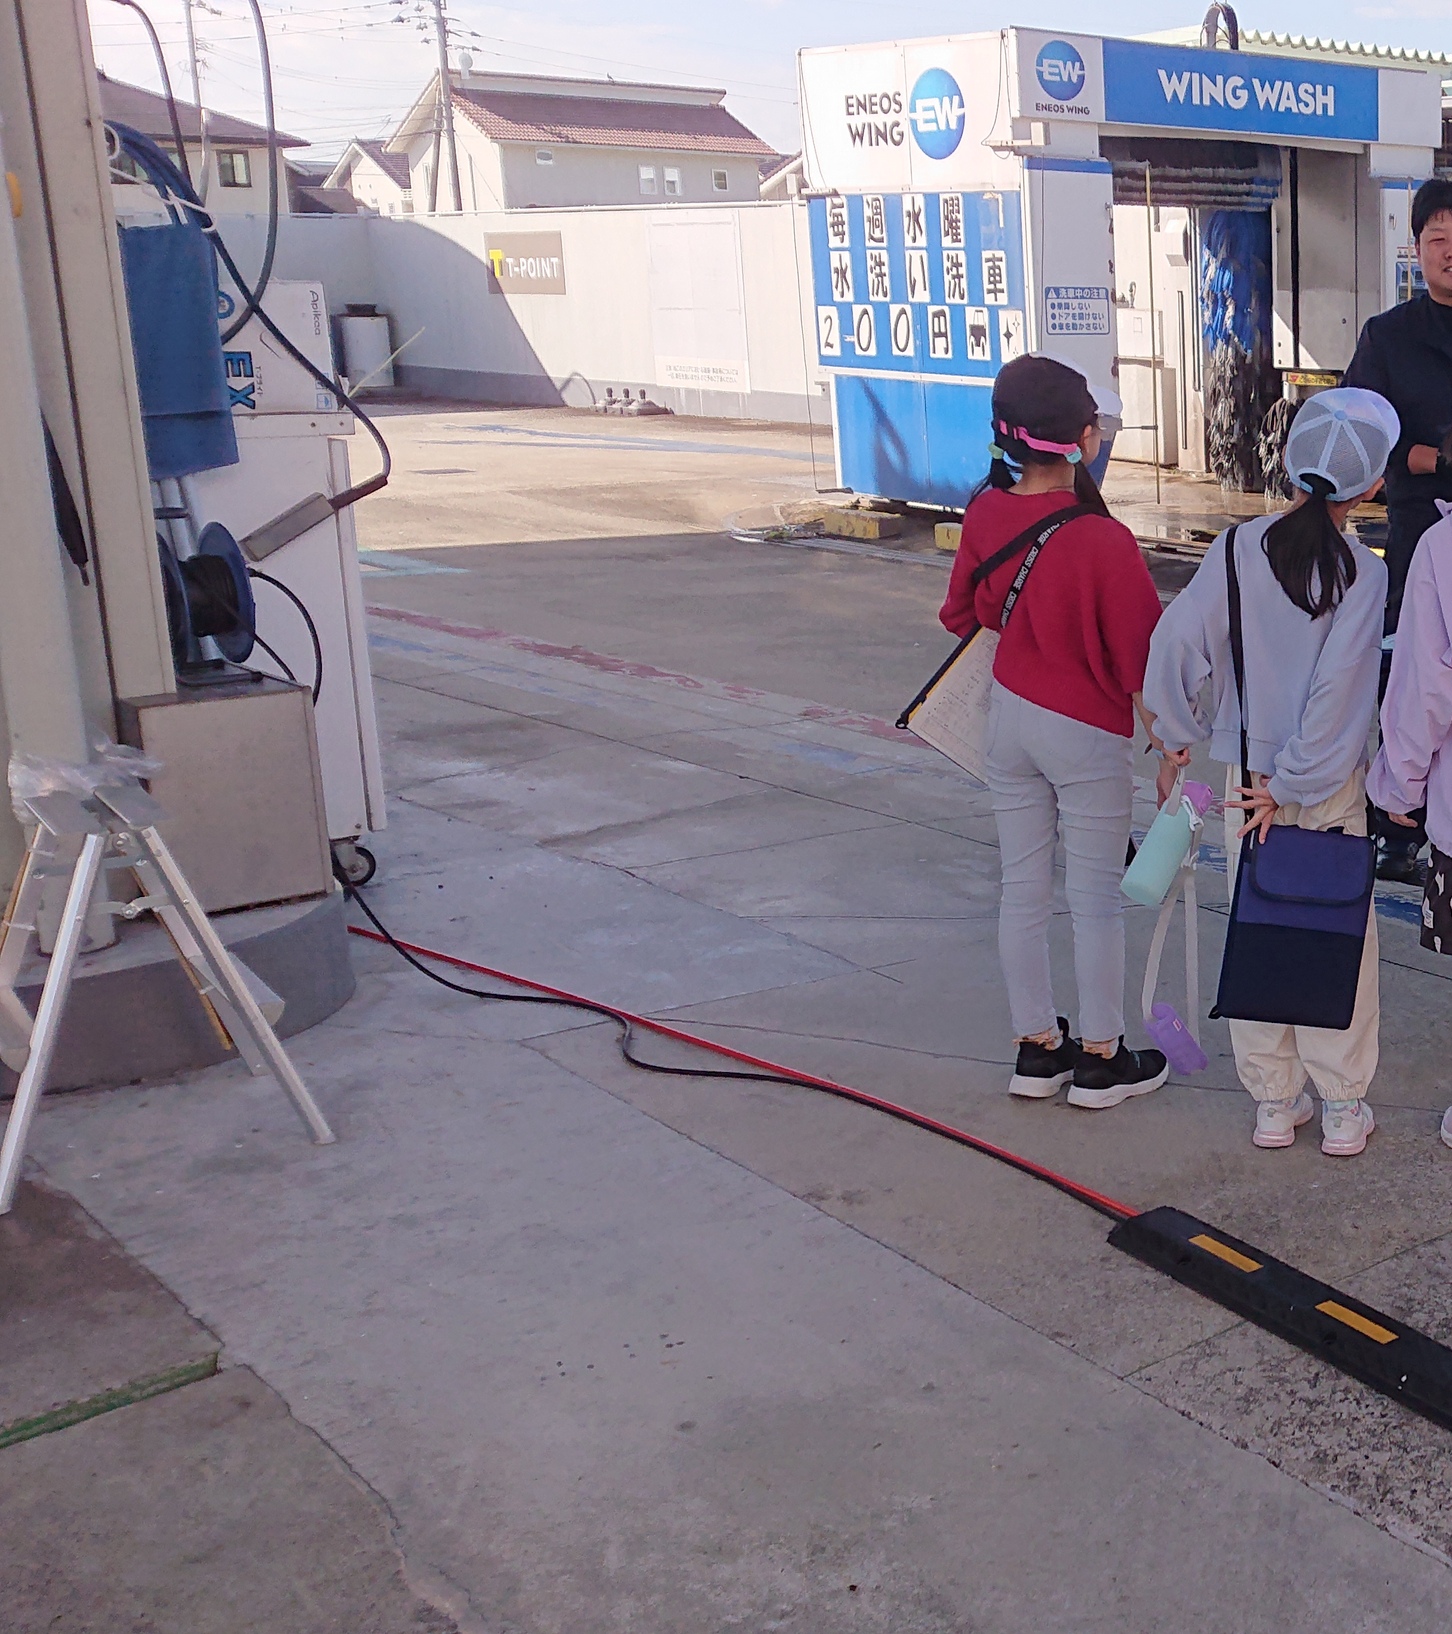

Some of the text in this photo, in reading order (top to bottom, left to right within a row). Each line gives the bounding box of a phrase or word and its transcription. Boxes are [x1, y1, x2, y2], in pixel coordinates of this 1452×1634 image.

[845, 91, 903, 116] ENEOS
[1035, 102, 1090, 116] ENEOS WING
[1157, 68, 1335, 117] WING WASH
[847, 119, 904, 149] WING
[829, 195, 963, 244] 毎週水曜
[505, 257, 559, 279] T-POINT
[833, 252, 1005, 302] 水洗い洗車
[222, 351, 256, 410] EX
